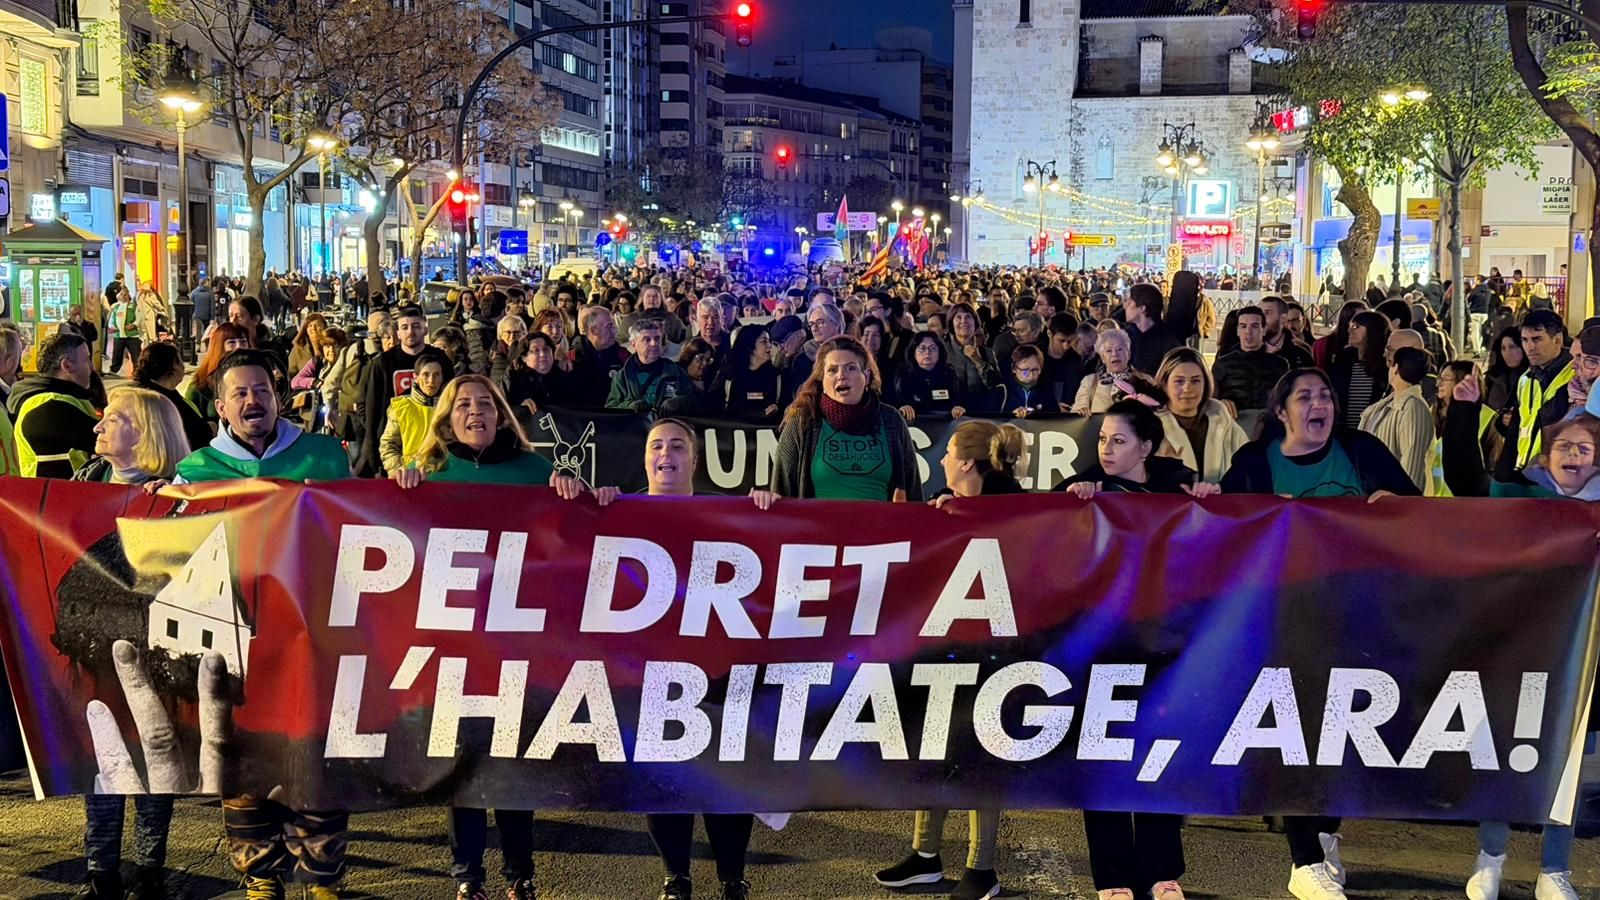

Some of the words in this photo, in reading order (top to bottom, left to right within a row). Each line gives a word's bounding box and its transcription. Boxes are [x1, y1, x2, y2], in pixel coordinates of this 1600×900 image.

[1195, 183, 1222, 215] P
[1184, 224, 1230, 236] COMPLETO
[828, 439, 879, 453] STOP
[828, 453, 882, 462] DESAHUCIOS
[328, 523, 546, 632] PEL
[579, 535, 911, 640] DRET
[917, 538, 1019, 637] A
[1210, 667, 1549, 773] ARA!
